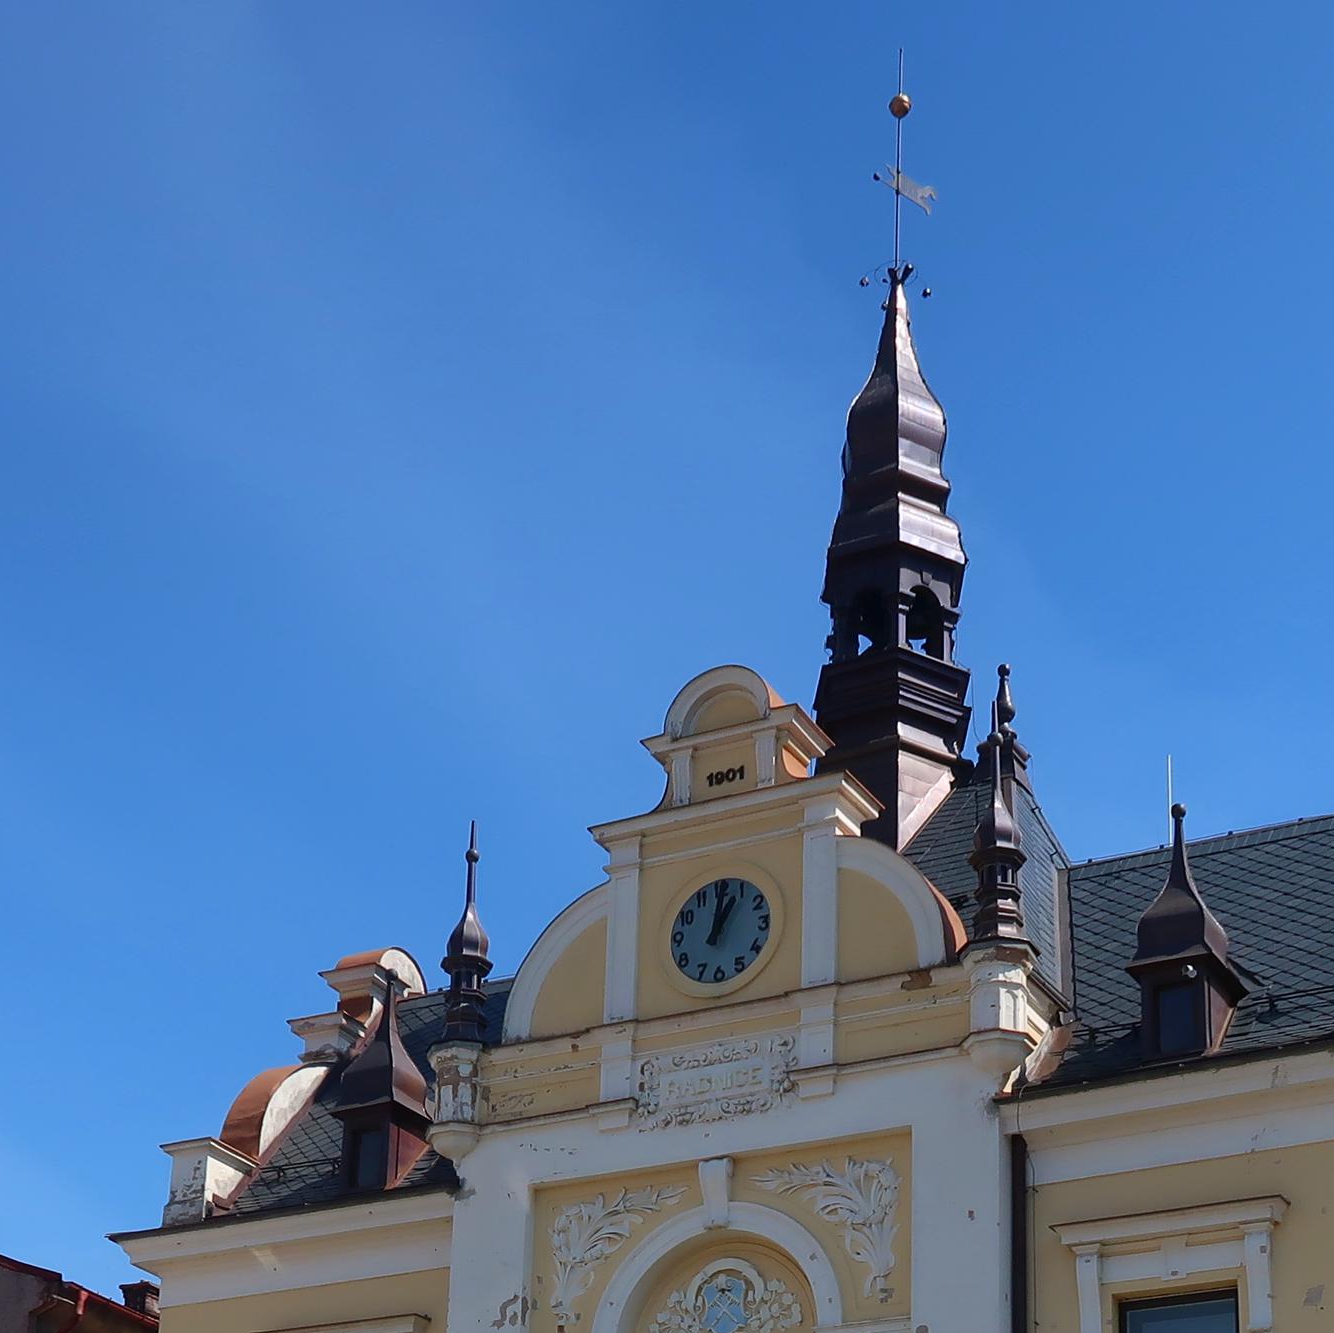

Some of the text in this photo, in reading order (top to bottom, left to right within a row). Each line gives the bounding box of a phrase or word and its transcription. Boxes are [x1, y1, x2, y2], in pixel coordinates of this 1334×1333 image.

[706, 765, 745, 787] 1901
[739, 882, 744, 898] 1
[696, 891, 707, 908] 11
[752, 894, 764, 911] 2
[680, 909, 694, 927] 10
[757, 913, 770, 931] 3
[673, 931, 684, 947] 9
[750, 937, 763, 954] 4
[678, 952, 689, 968] 8
[734, 956, 745, 972] 5
[697, 962, 707, 980] 7
[713, 965, 725, 981] 6
